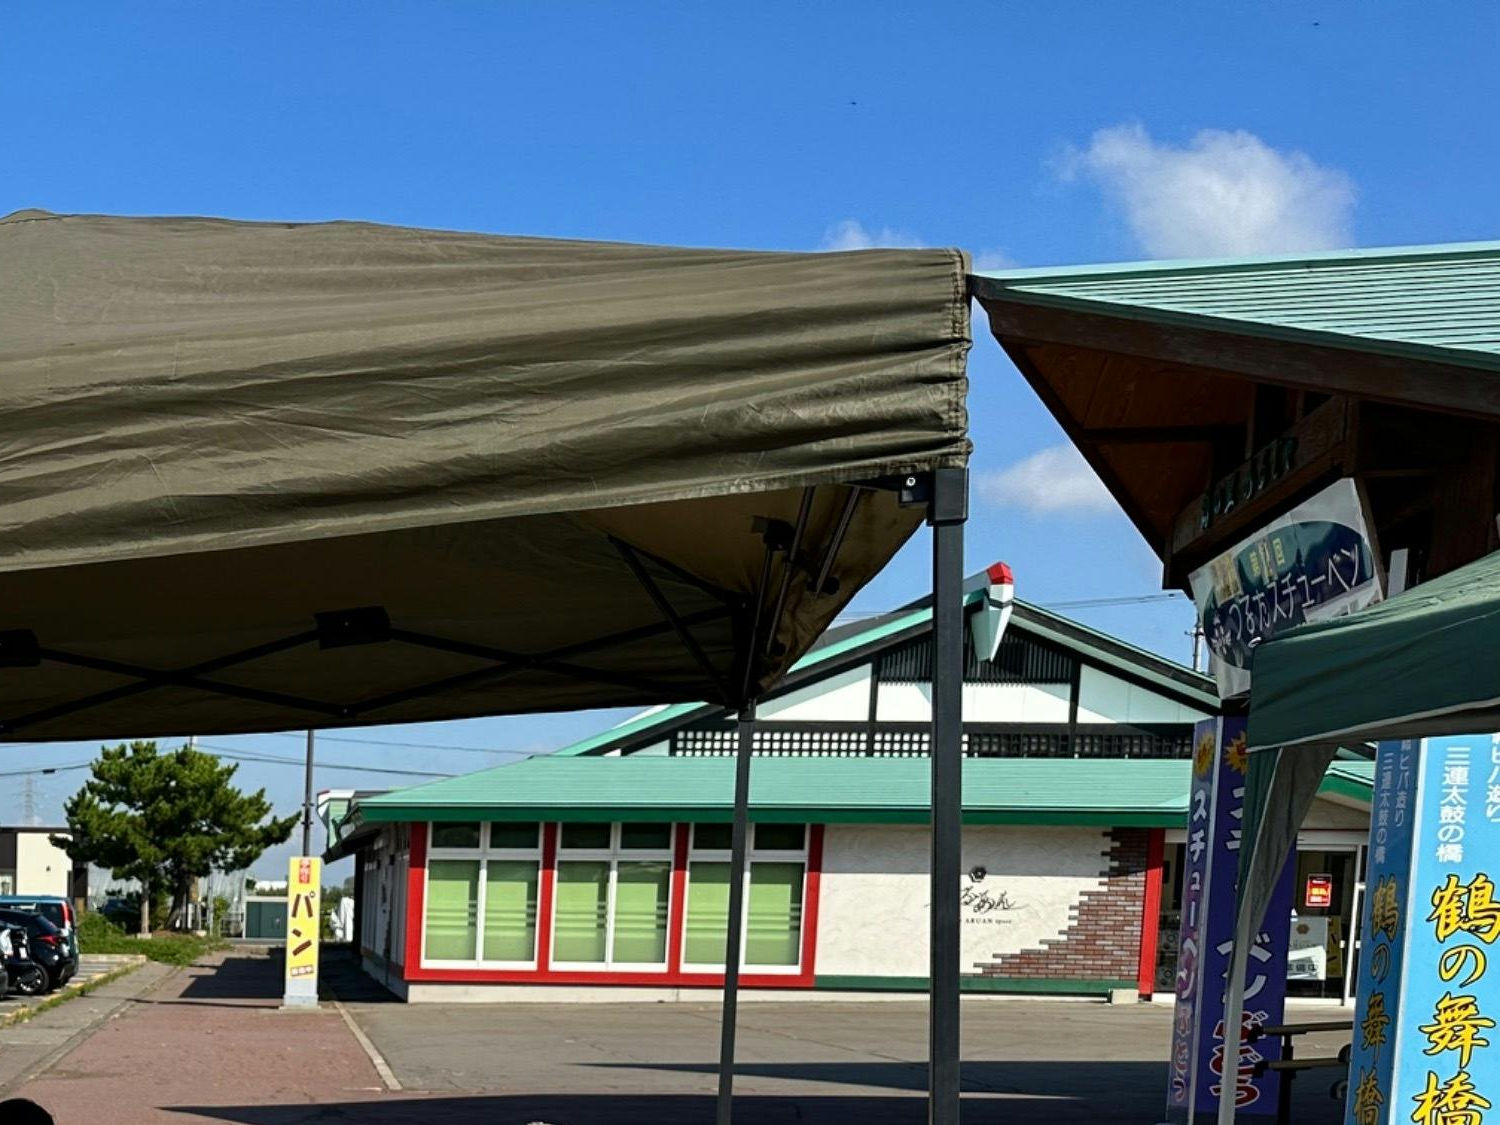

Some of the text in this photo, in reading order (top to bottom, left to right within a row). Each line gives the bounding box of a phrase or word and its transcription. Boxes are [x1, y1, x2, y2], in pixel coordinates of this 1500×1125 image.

[1436, 747, 1471, 863] 三連太鼓の橋
[291, 890, 316, 957] パン
